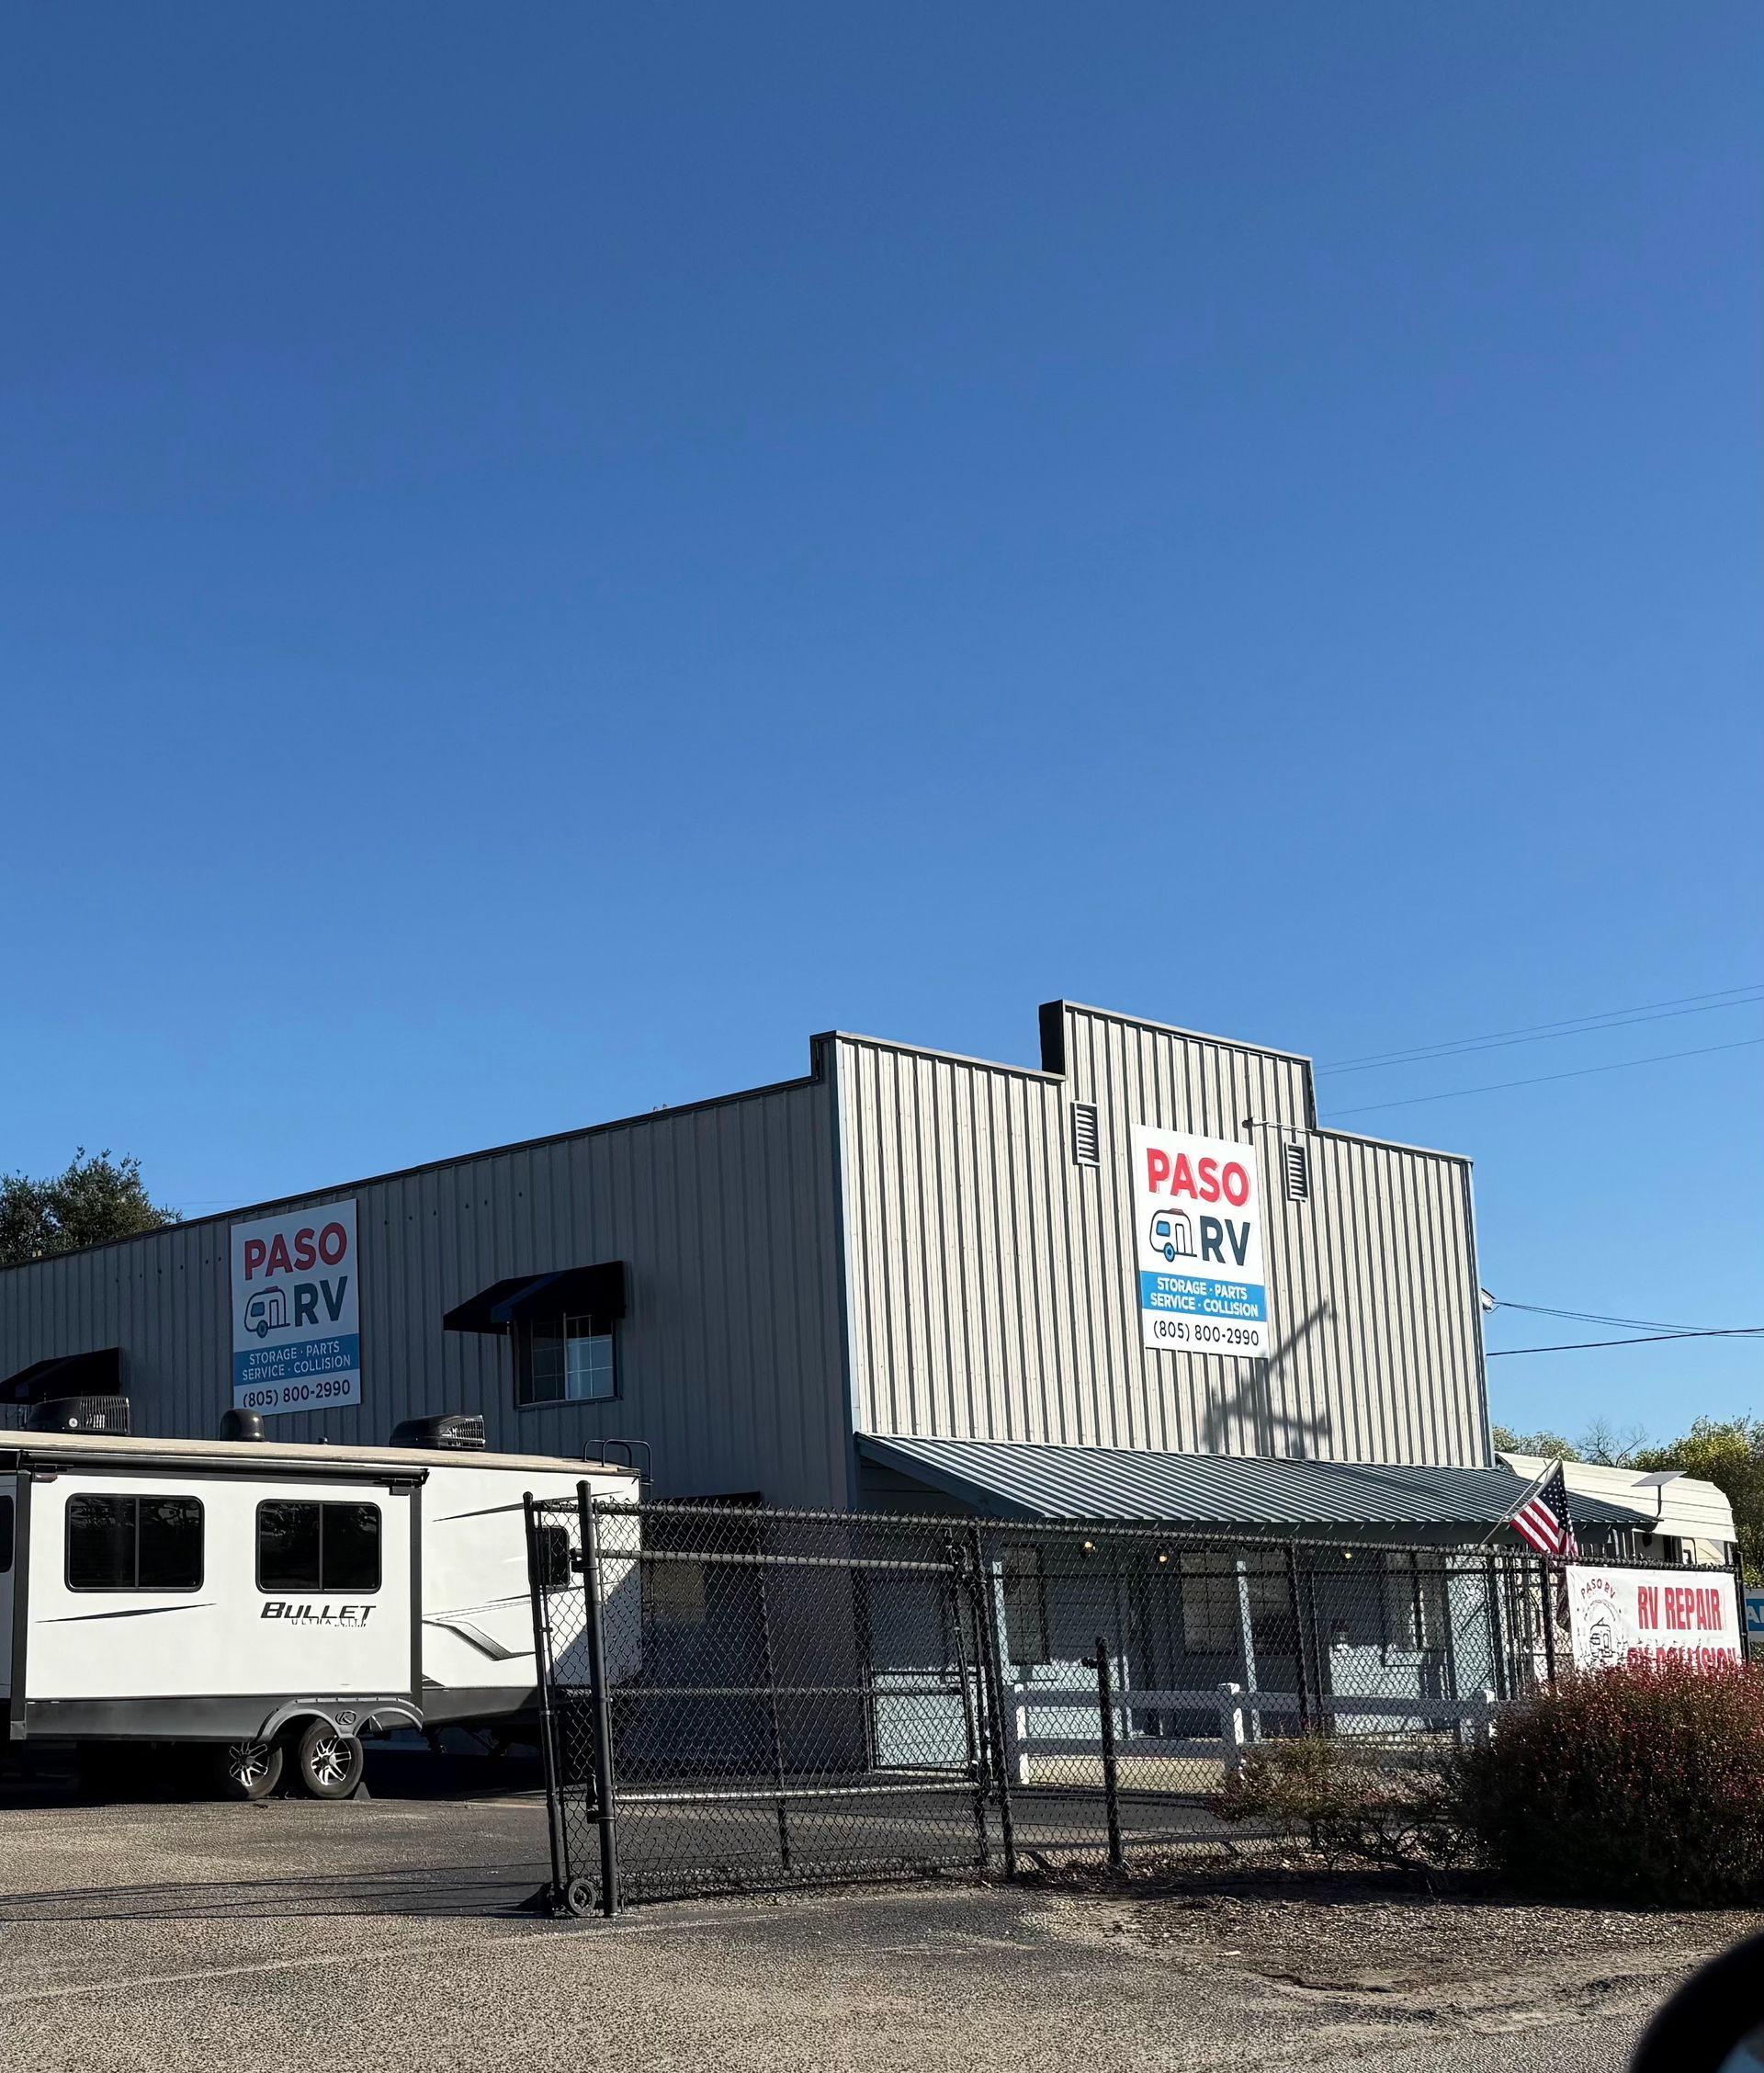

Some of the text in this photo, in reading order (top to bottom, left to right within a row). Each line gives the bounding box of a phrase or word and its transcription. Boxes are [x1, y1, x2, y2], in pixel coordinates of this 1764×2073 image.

[1147, 1148, 1250, 1206] PASO
[244, 1222, 347, 1280] PASO
[1200, 1215, 1250, 1266] RV
[294, 1275, 348, 1327] RV
[1157, 1276, 1247, 1300] STORAGE PARTS
[1150, 1293, 1258, 1317] SERVICE COLLISION
[1153, 1320, 1259, 1346] (805) 800-2990
[242, 1354, 351, 1381] SERVICE COLLISION
[249, 1342, 340, 1365] STORAGE PARTS
[243, 1379, 350, 1409] (805) 800-2990
[1580, 1579, 1615, 1599] PASO RV
[1637, 1586, 1724, 1630] RV REPAIR
